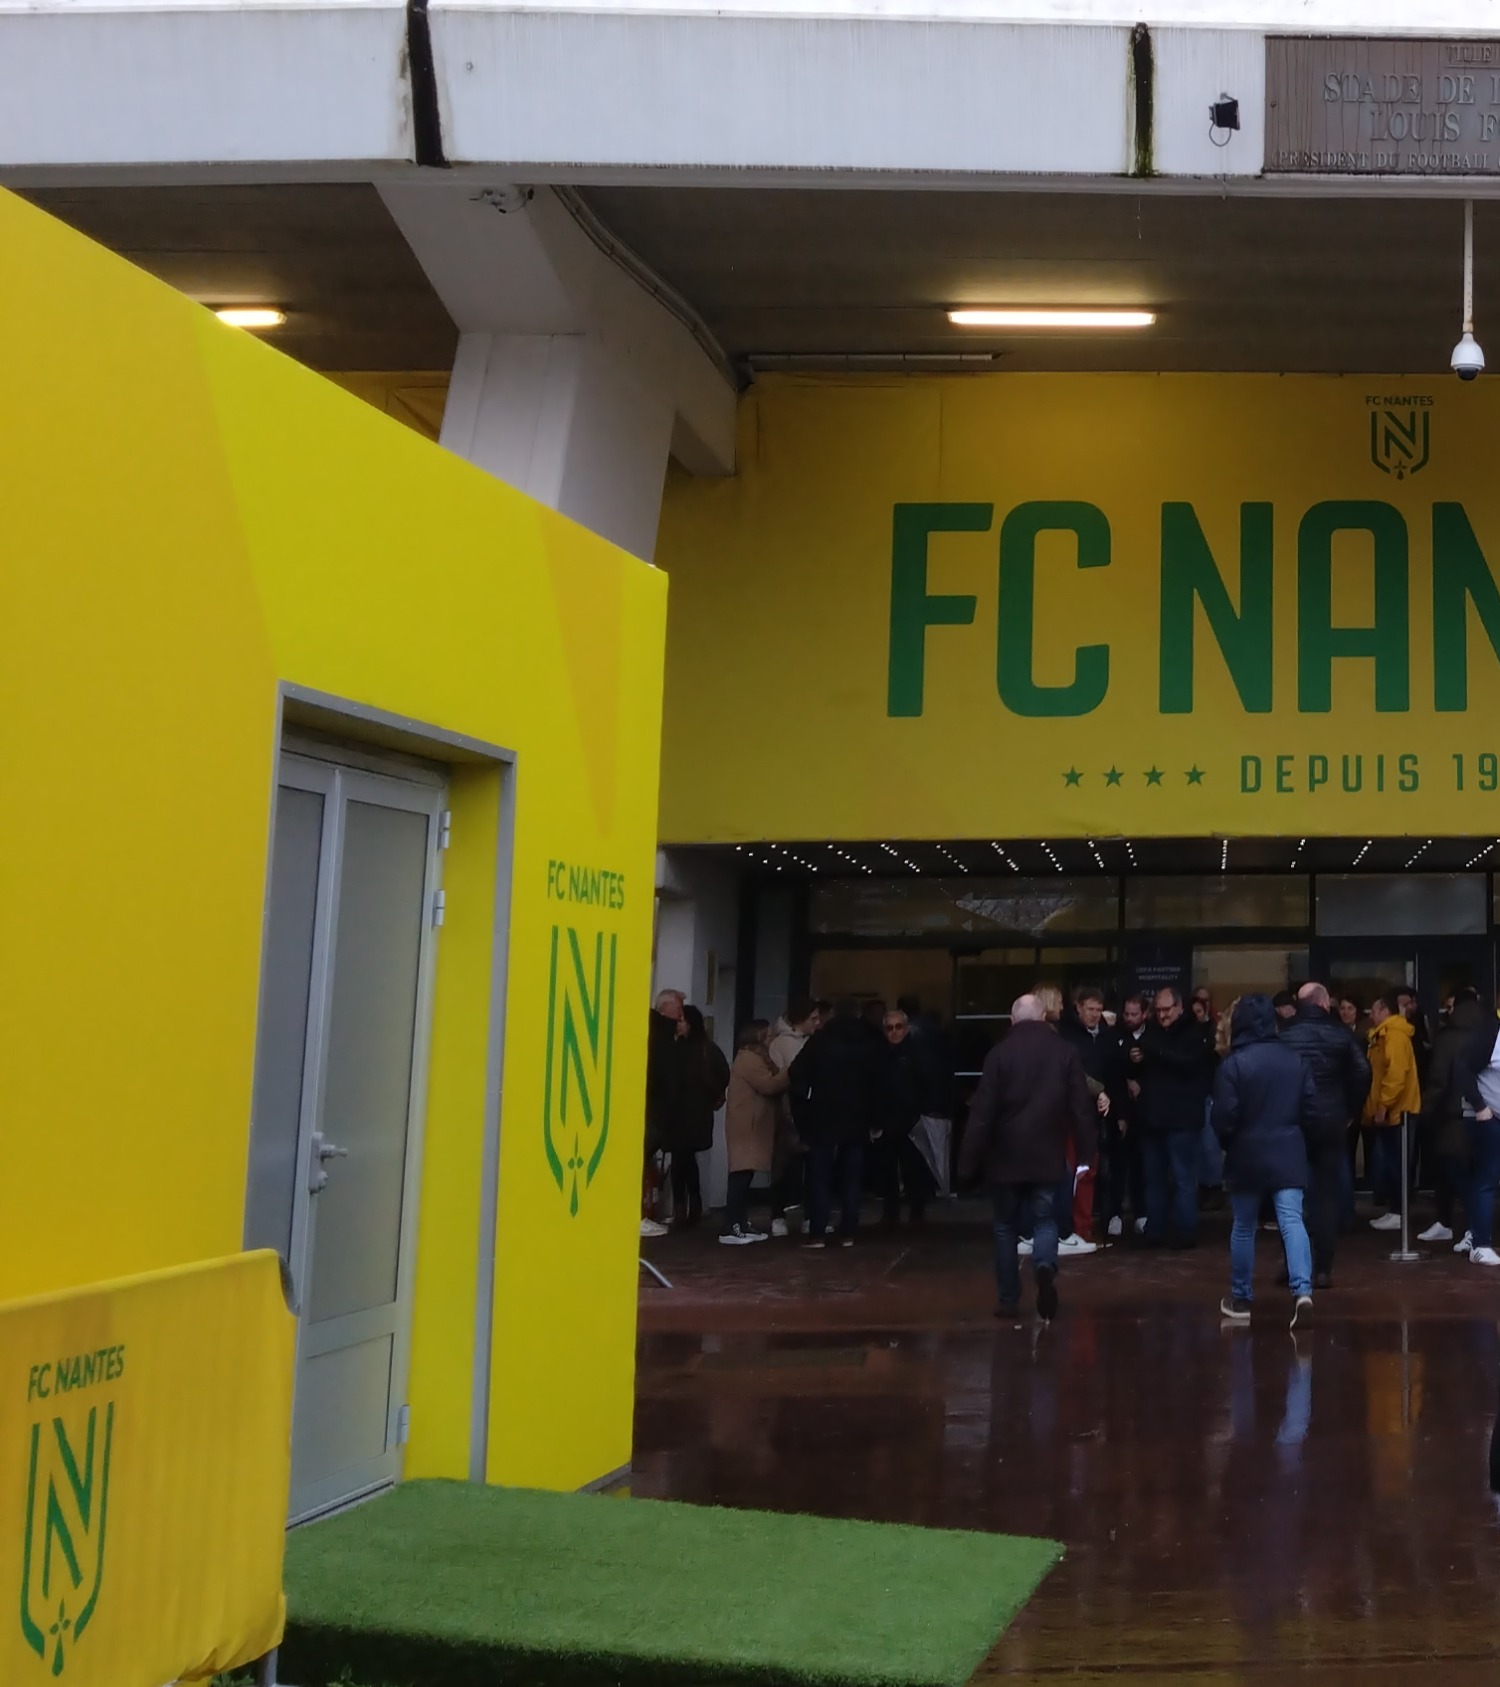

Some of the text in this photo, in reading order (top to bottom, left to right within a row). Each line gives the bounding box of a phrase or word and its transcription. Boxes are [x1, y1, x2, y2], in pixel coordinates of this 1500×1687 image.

[1324, 72, 1422, 104] STADE
[1437, 75, 1475, 105] DE
[1370, 111, 1461, 142] LOUIS
[1377, 152, 1400, 168] DU
[1408, 152, 1489, 169] FOOTBALL
[1366, 395, 1434, 406] FC NANTES
[887, 500, 1111, 718] FC
[1240, 753, 1421, 794] DEPUIS
[547, 859, 625, 911] FC NANTES
[27, 1344, 126, 1403] FC NANTES
